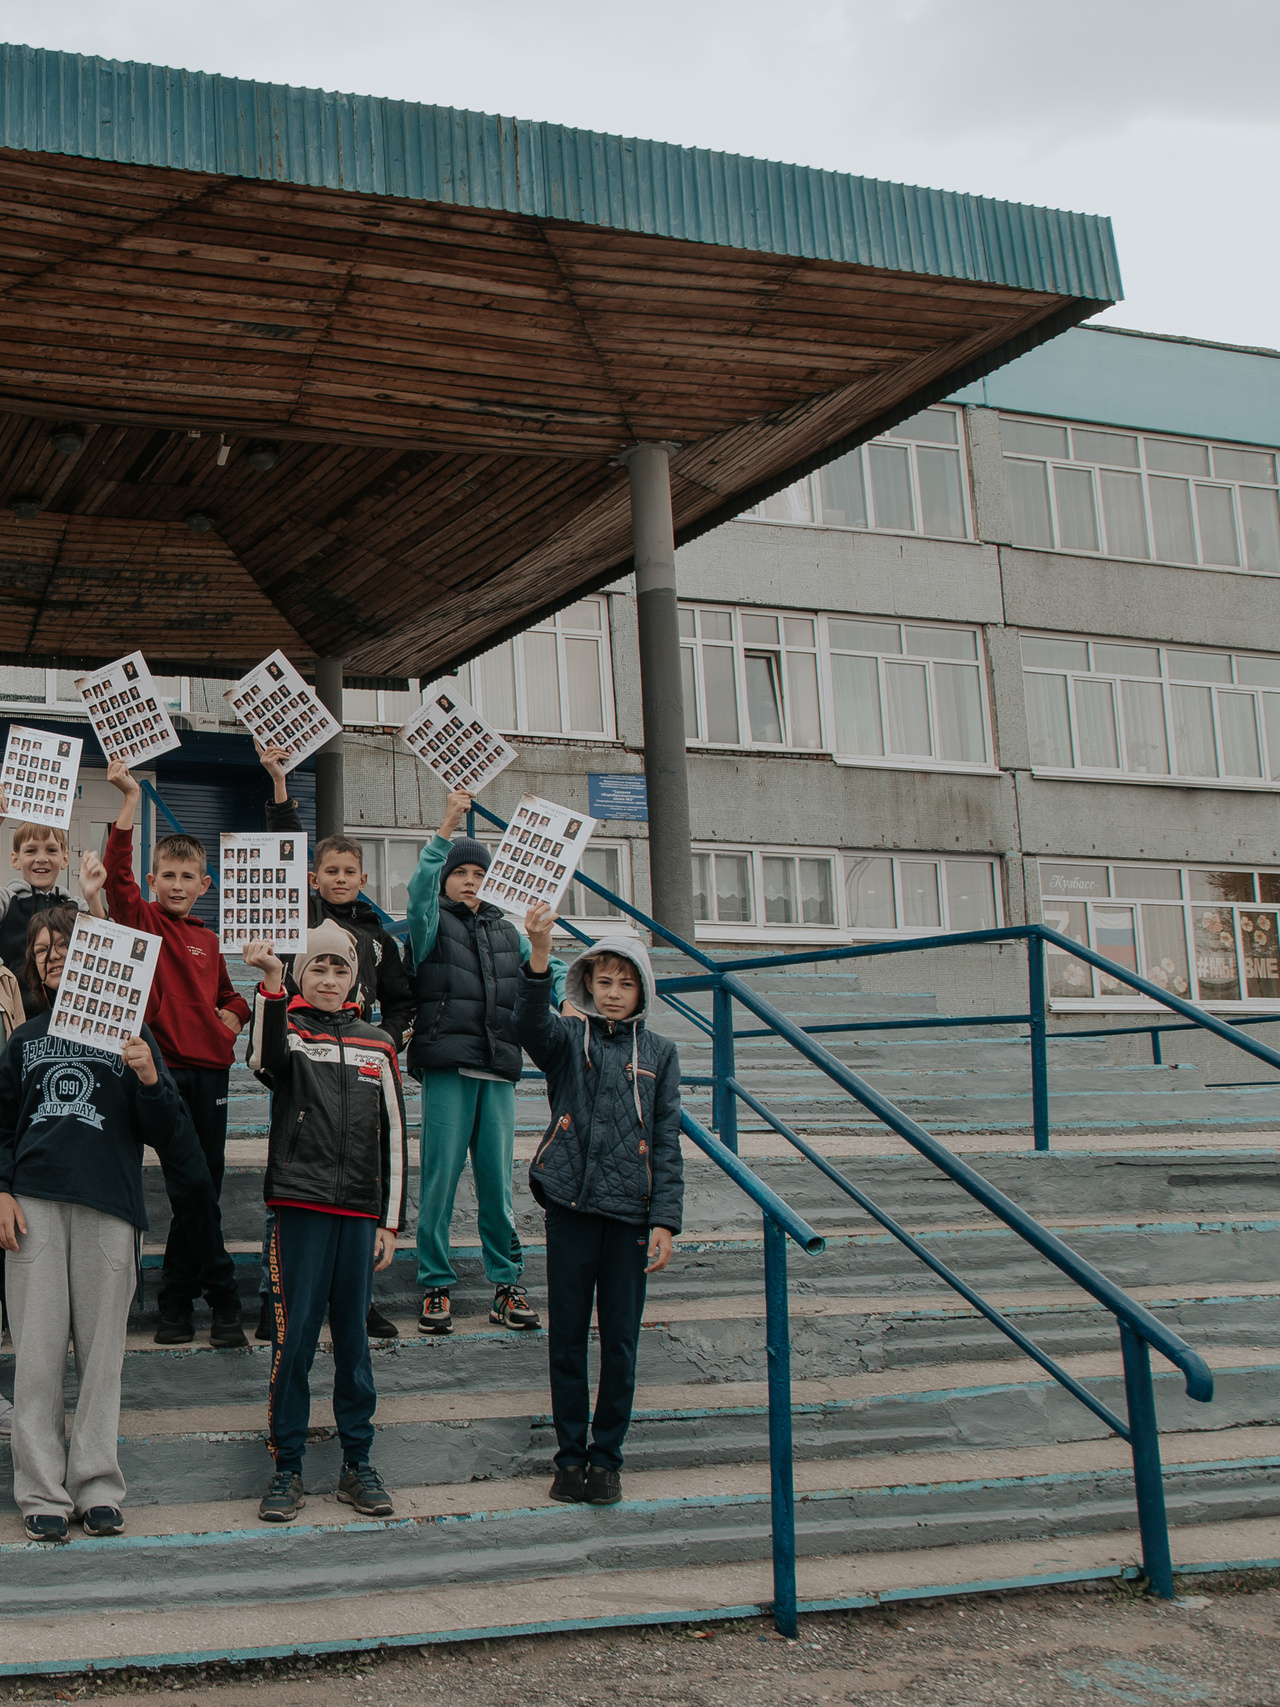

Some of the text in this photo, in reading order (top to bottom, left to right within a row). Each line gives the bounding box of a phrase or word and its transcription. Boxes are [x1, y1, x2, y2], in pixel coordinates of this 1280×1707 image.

[58, 1080, 80, 1095] 1991
[38, 1103, 66, 1117] ENJOY
[274, 1302, 285, 1344] MESSI
[271, 1350, 282, 1384] NETO
